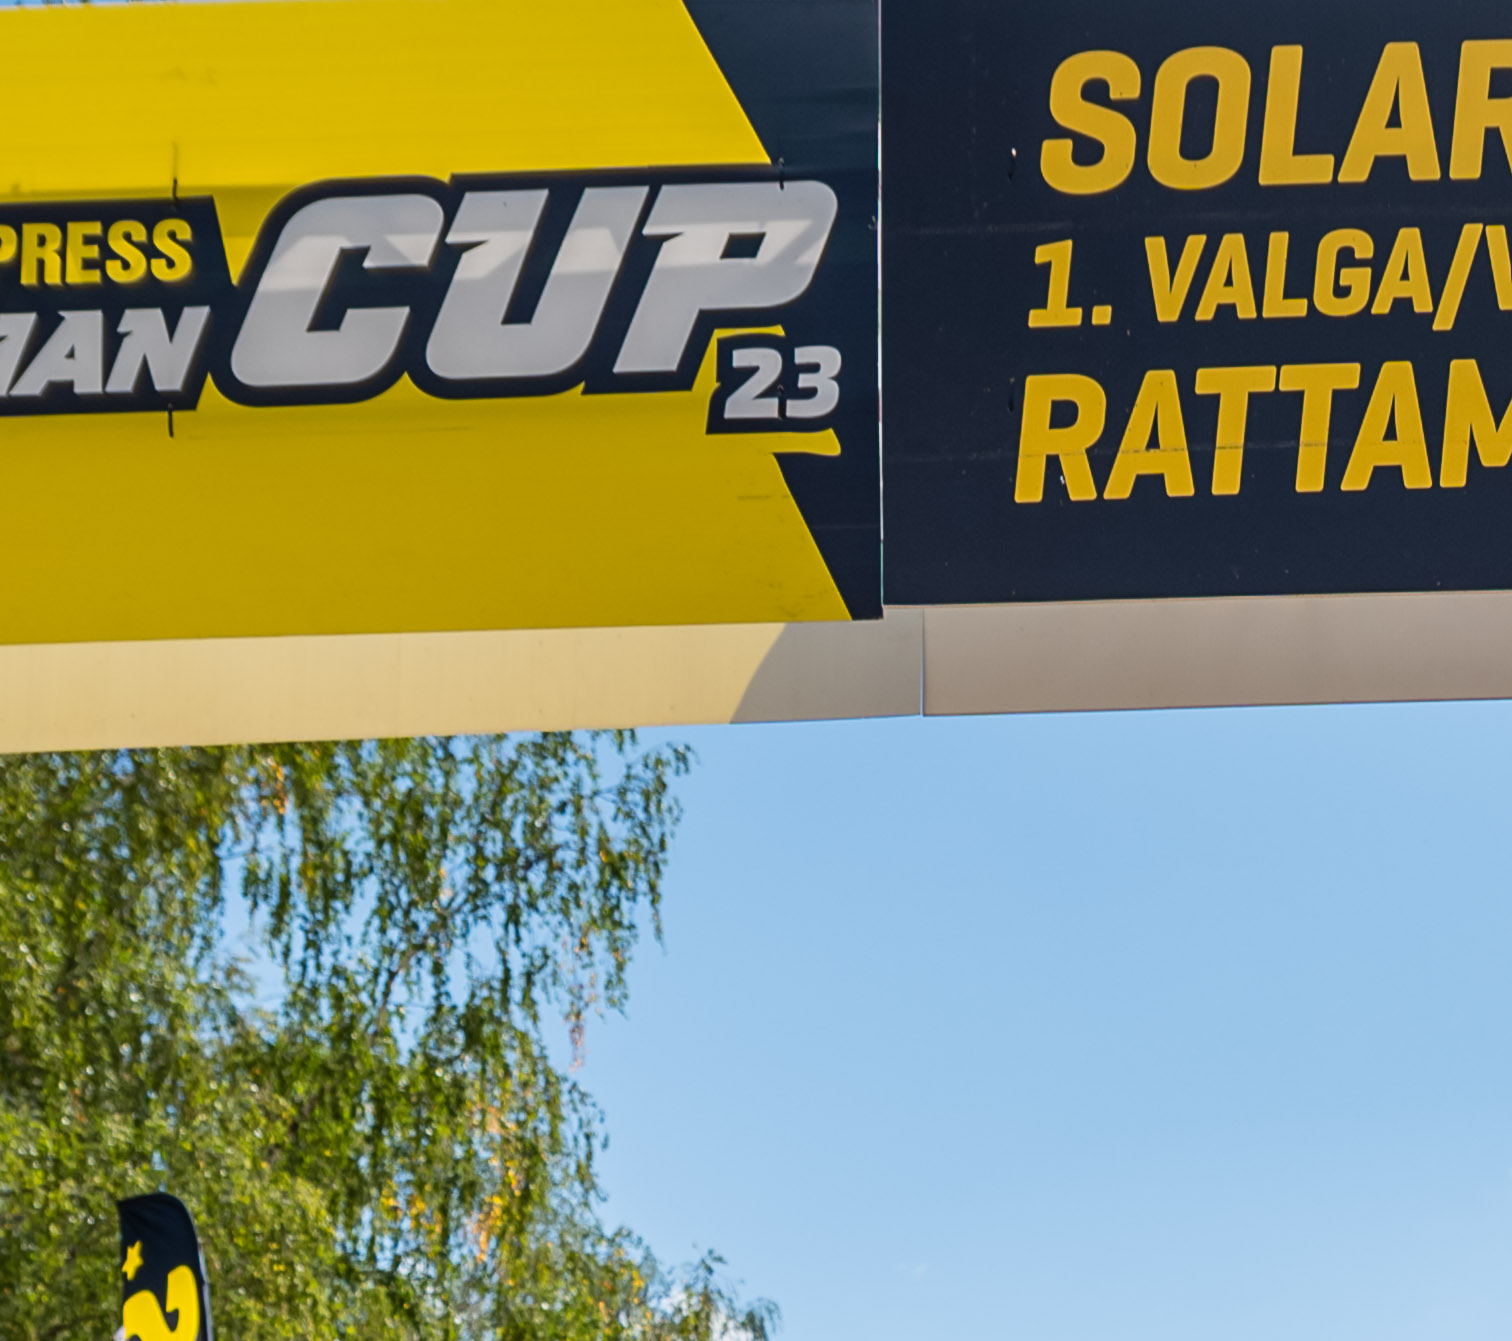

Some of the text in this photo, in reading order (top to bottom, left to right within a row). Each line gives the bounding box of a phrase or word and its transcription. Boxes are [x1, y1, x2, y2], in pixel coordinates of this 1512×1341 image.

[230, 179, 839, 386] CUP
[1028, 238, 1113, 328] 1.
[723, 346, 841, 419] 23
